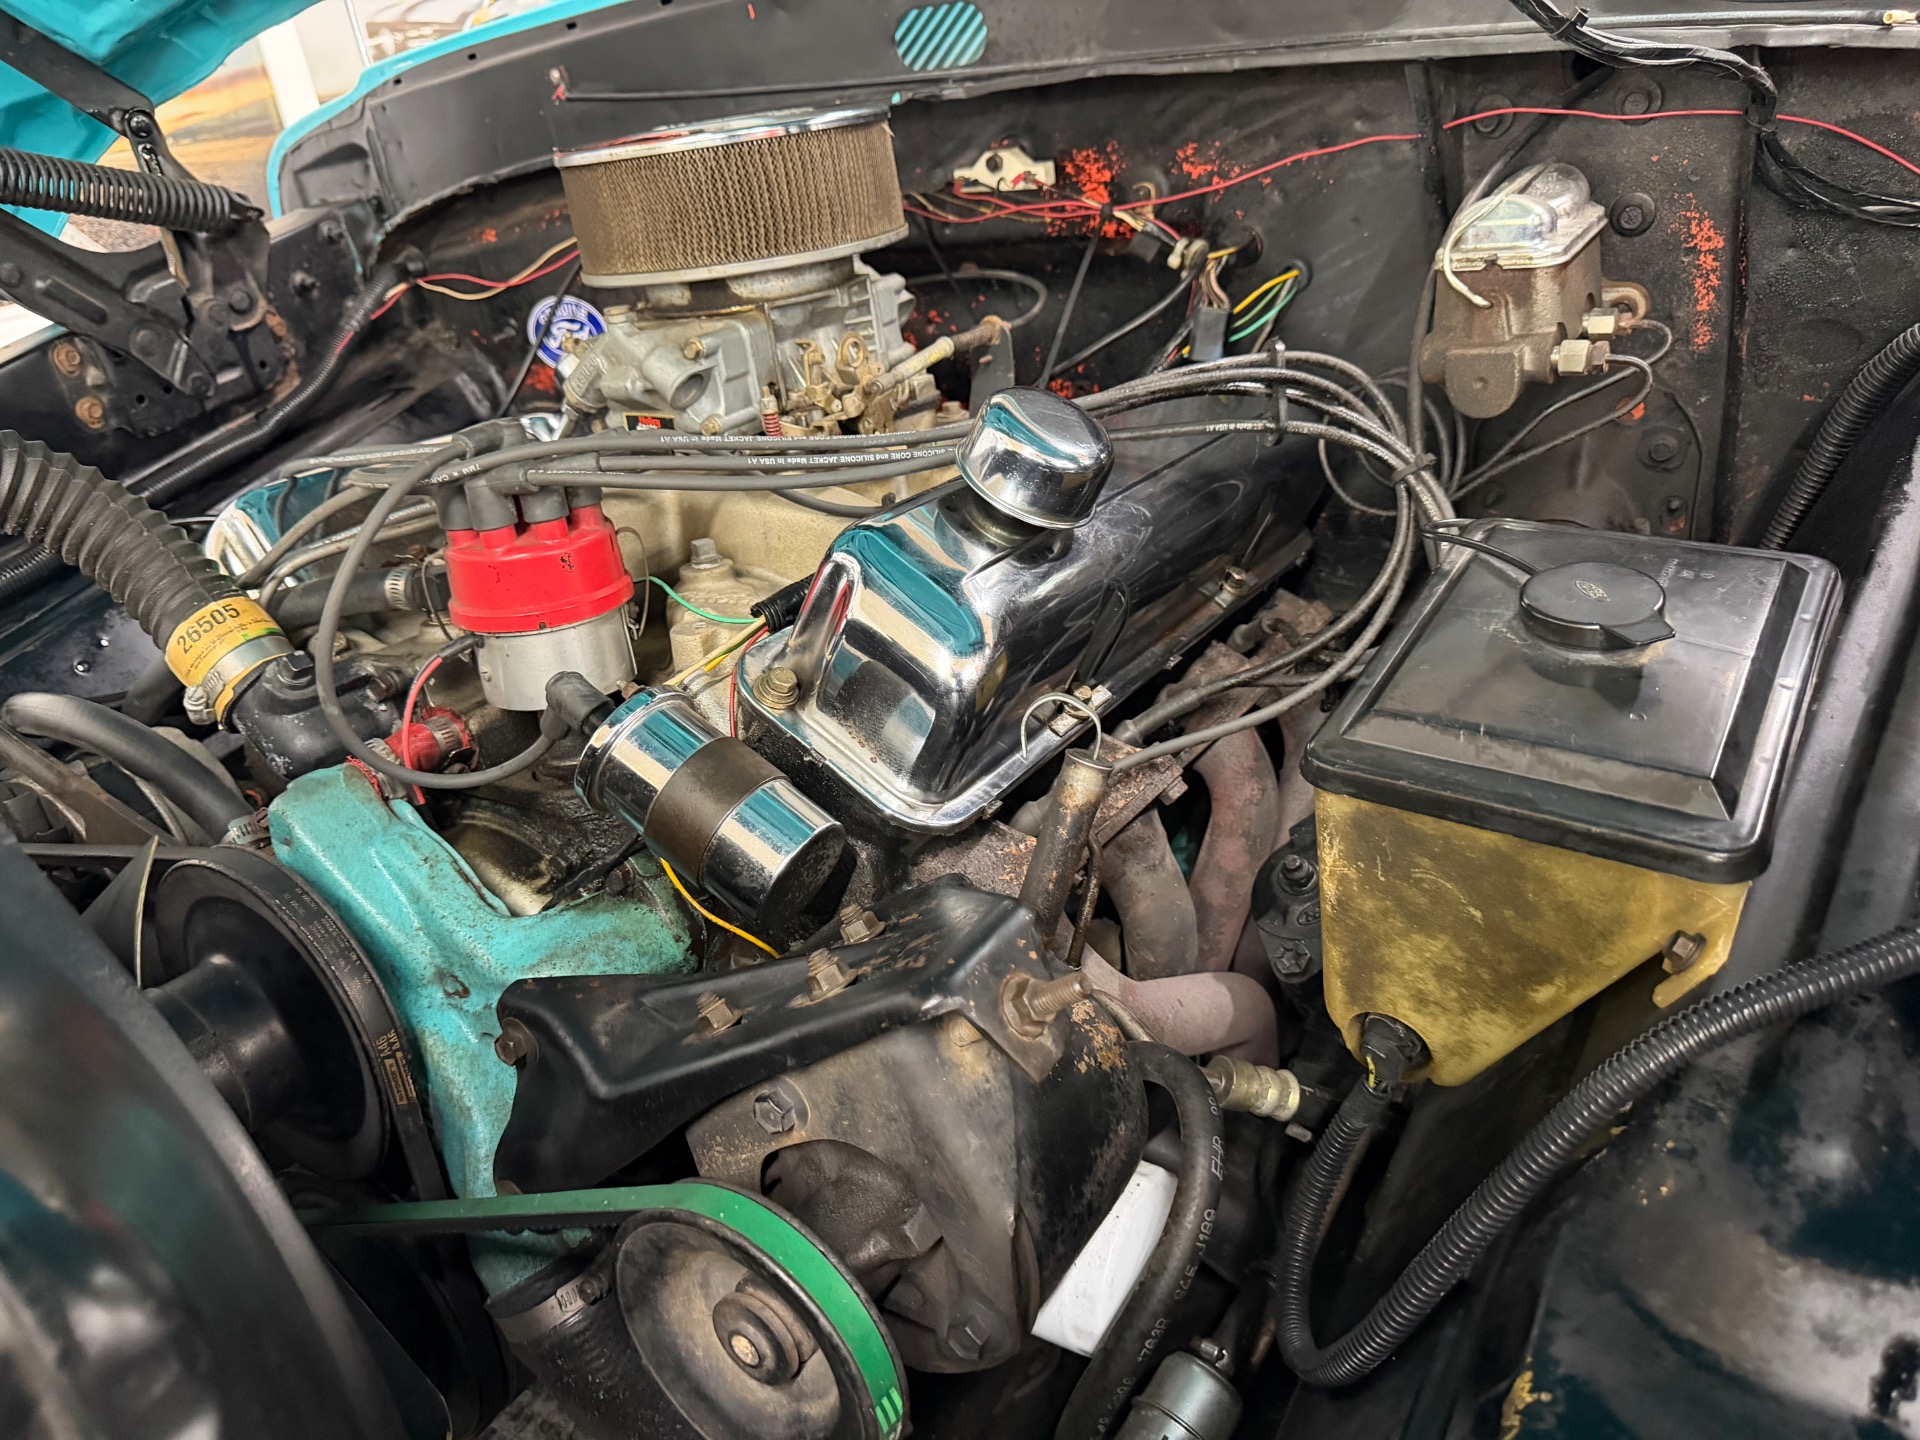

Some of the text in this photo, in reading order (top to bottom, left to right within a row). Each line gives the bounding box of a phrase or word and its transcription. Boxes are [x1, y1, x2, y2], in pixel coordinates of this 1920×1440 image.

[808, 456, 838, 464] JACKET
[840, 454, 875, 463] SILICONE
[890, 450, 911, 460] CORE
[461, 463, 482, 475] 7MM
[177, 604, 241, 655] 26505
[375, 1035, 392, 1057] A46
